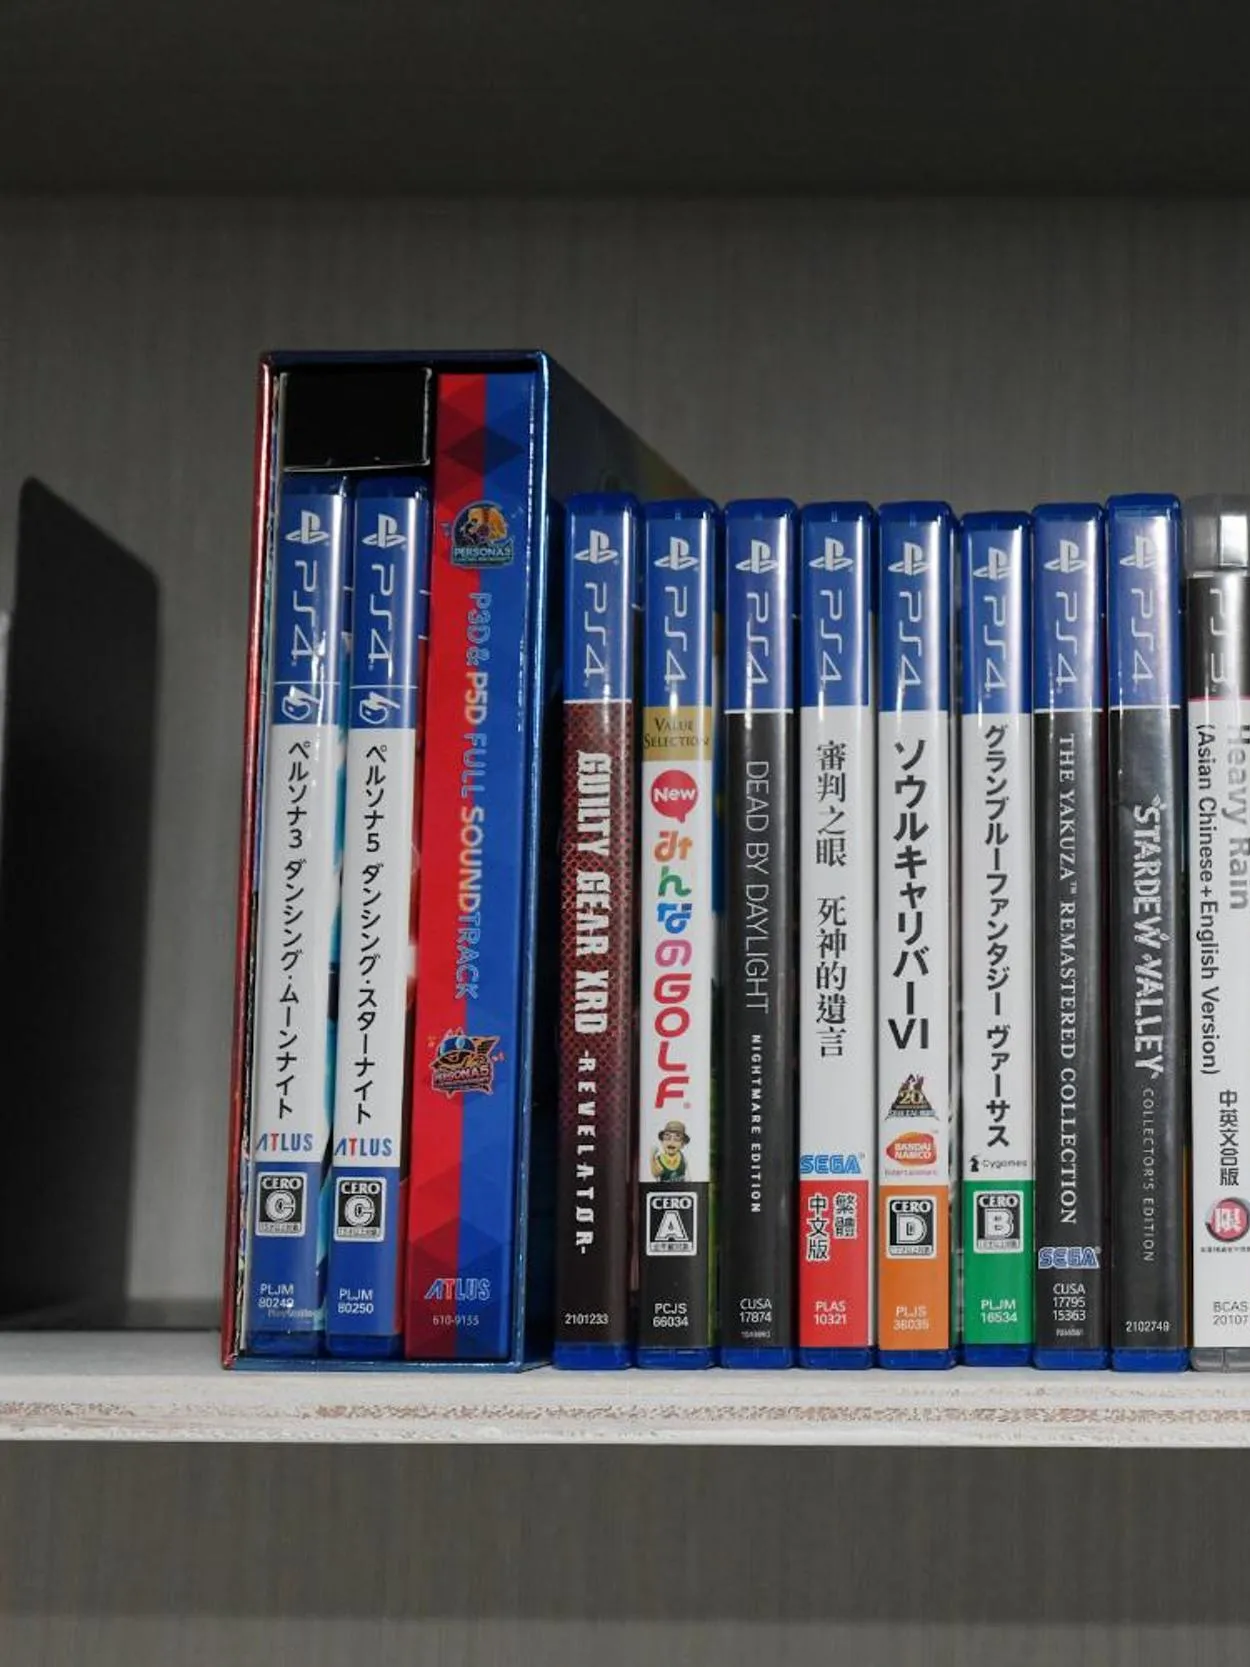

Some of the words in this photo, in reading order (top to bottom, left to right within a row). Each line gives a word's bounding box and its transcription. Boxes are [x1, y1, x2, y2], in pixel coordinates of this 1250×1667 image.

[291, 559, 319, 667] PS4
[366, 563, 395, 669] PS4
[584, 582, 607, 680] PS4
[664, 585, 687, 682] PS4
[746, 591, 769, 684] PS4
[820, 589, 843, 683] PS4
[899, 591, 922, 687] PS4
[984, 595, 1007, 691] PS4
[1056, 591, 1078, 687] PS4
[1131, 588, 1154, 681] PS4
[642, 733, 709, 749] SELECTION
[1059, 733, 1075, 783] THE
[461, 732, 487, 798] FULL
[286, 741, 311, 849] ペルソナ3
[364, 744, 389, 853] ペルソナ5
[576, 750, 612, 857] GUILTY
[652, 785, 696, 802] New
[745, 761, 769, 833] DEAD
[816, 739, 847, 868] 審判之眼
[745, 841, 769, 875] BY
[1133, 803, 1164, 950] STARDEW
[455, 804, 486, 1000] SOUNDTRACK
[575, 869, 612, 957] GEAR
[745, 884, 769, 1014] DAYLIGHT
[815, 895, 848, 1058] 死神的遺言
[1059, 901, 1077, 1060] REMASTERED
[574, 969, 609, 1034] XRD
[1133, 955, 1164, 1080] VALLEY
[1198, 986, 1221, 1076] Version)
[750, 1034, 761, 1136] NIGHTMARE
[255, 1133, 313, 1152] ATLUS
[334, 1137, 393, 1157] ATLUS
[1060, 1066, 1078, 1225] COLLECTION
[1218, 1089, 1240, 1187] 中英文合版
[262, 1177, 302, 1191] CERO
[750, 1142, 761, 1213] EDITION
[799, 1153, 861, 1174] SEGA
[265, 1190, 296, 1222] C
[341, 1182, 381, 1196] CERO
[651, 1196, 692, 1210] CERO
[891, 1200, 931, 1214] CERO
[977, 1195, 1018, 1209] CERO
[344, 1195, 375, 1227] C
[654, 1210, 689, 1241] A
[895, 1213, 927, 1245] D
[984, 1208, 1014, 1239] B
[1143, 1197, 1155, 1262] EDITION
[1038, 1247, 1099, 1270] SEGA
[259, 1283, 294, 1296] PLJM
[338, 1288, 374, 1301] PLJM
[424, 1278, 491, 1301] ATLUS
[654, 1302, 687, 1315] PCJS
[739, 1298, 772, 1310] CUSA
[814, 1300, 846, 1312] PLAS
[980, 1299, 1017, 1312] PLJM
[1052, 1283, 1086, 1295] CUSA
[1212, 1301, 1249, 1313] BCAS
[564, 1313, 609, 1326] 2101233
[652, 1316, 689, 1328] 66034
[739, 1311, 772, 1324] 17874
[813, 1313, 846, 1325] 10321
[1052, 1309, 1086, 1322] 15363
